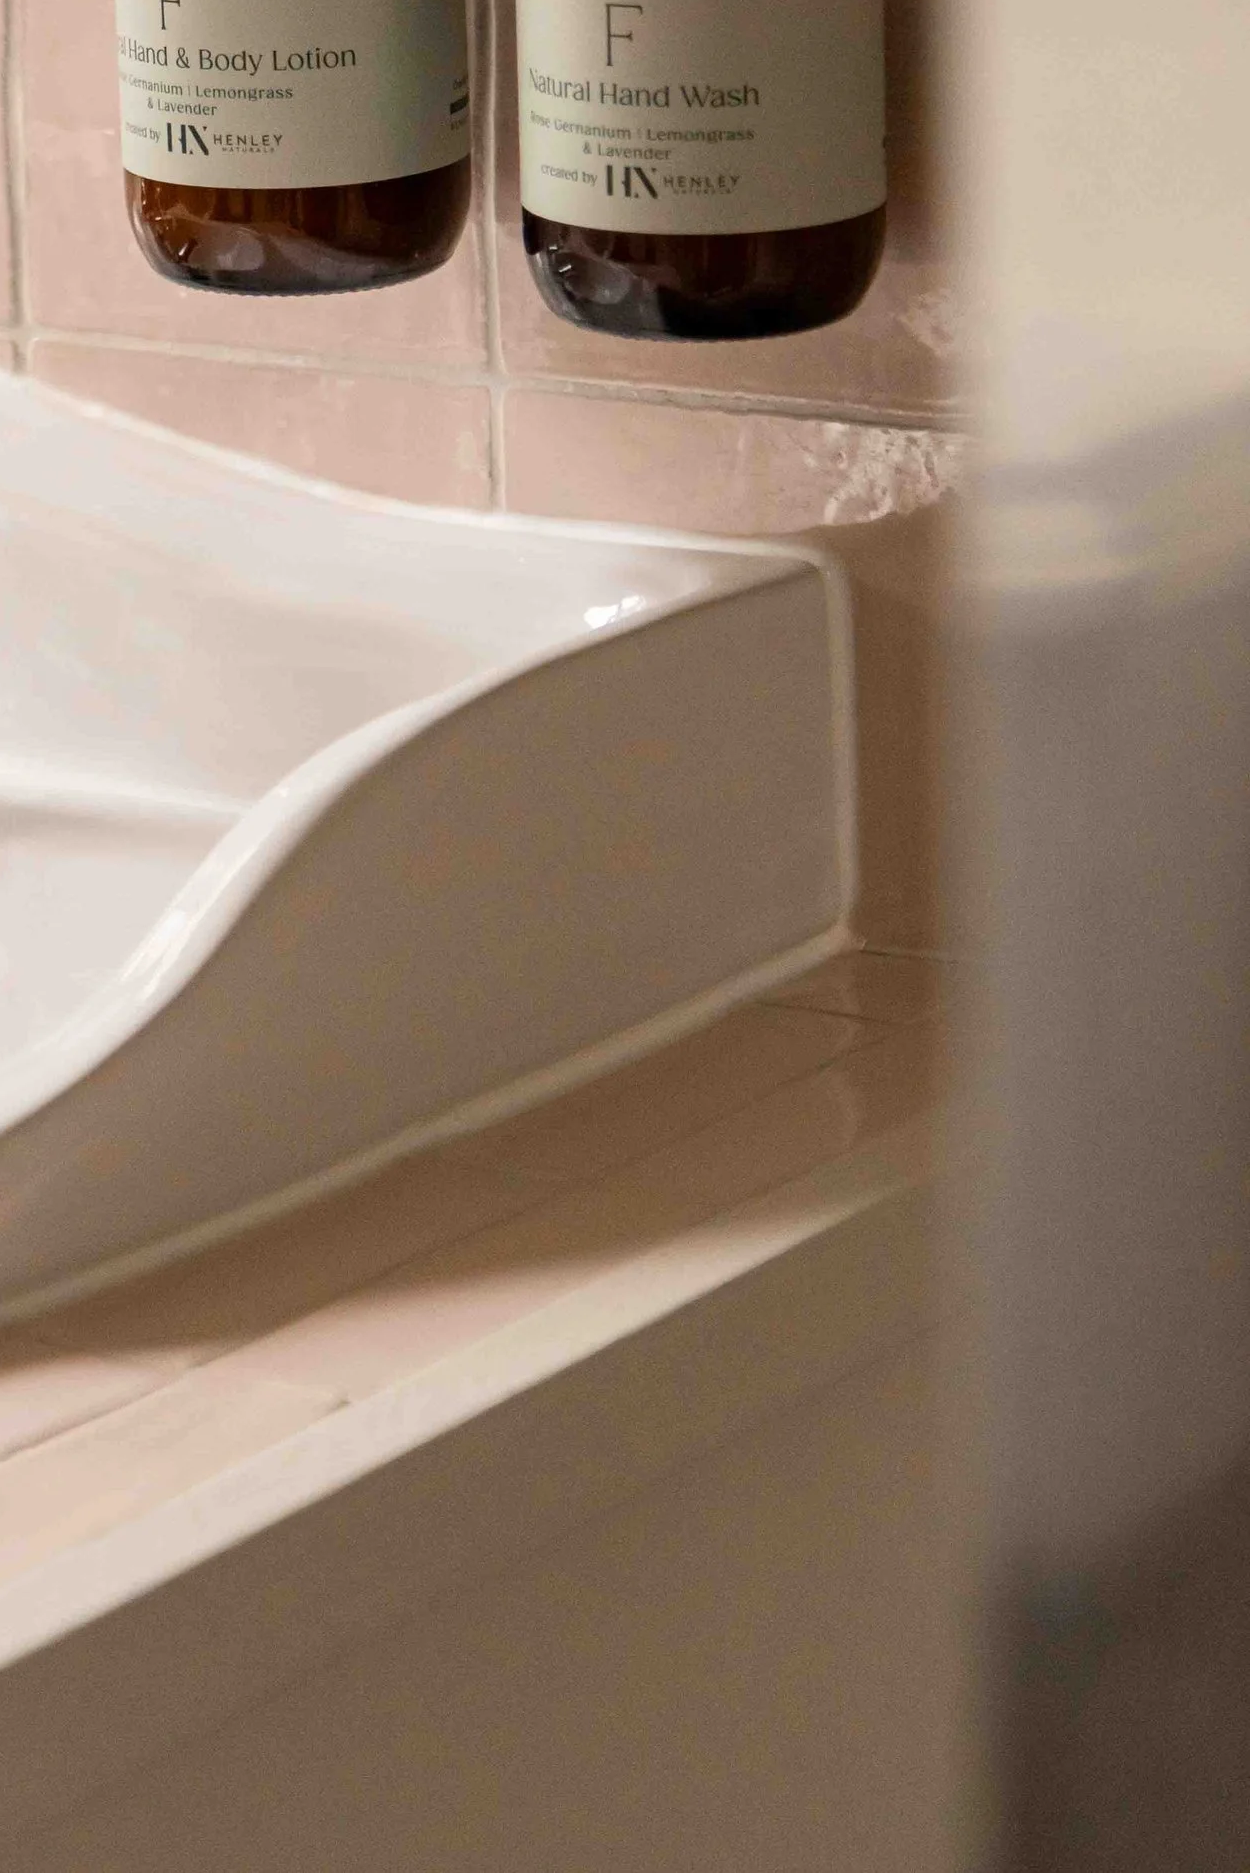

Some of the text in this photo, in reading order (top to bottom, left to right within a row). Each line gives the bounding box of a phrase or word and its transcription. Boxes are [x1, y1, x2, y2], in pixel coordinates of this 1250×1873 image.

[605, 3, 643, 66] F
[128, 38, 168, 67] Hand
[176, 47, 190, 69] &
[199, 48, 262, 76] Body
[272, 47, 357, 71] Lotion
[195, 85, 293, 101] Lemongrass
[529, 68, 760, 109] Natural Hand Wash
[157, 98, 218, 116] Lavender
[213, 134, 283, 146] HENLEY
[647, 128, 754, 143] Lemongrass
[597, 143, 672, 161] Lavender
[582, 171, 598, 187] by
[663, 174, 741, 189] HENLEY
